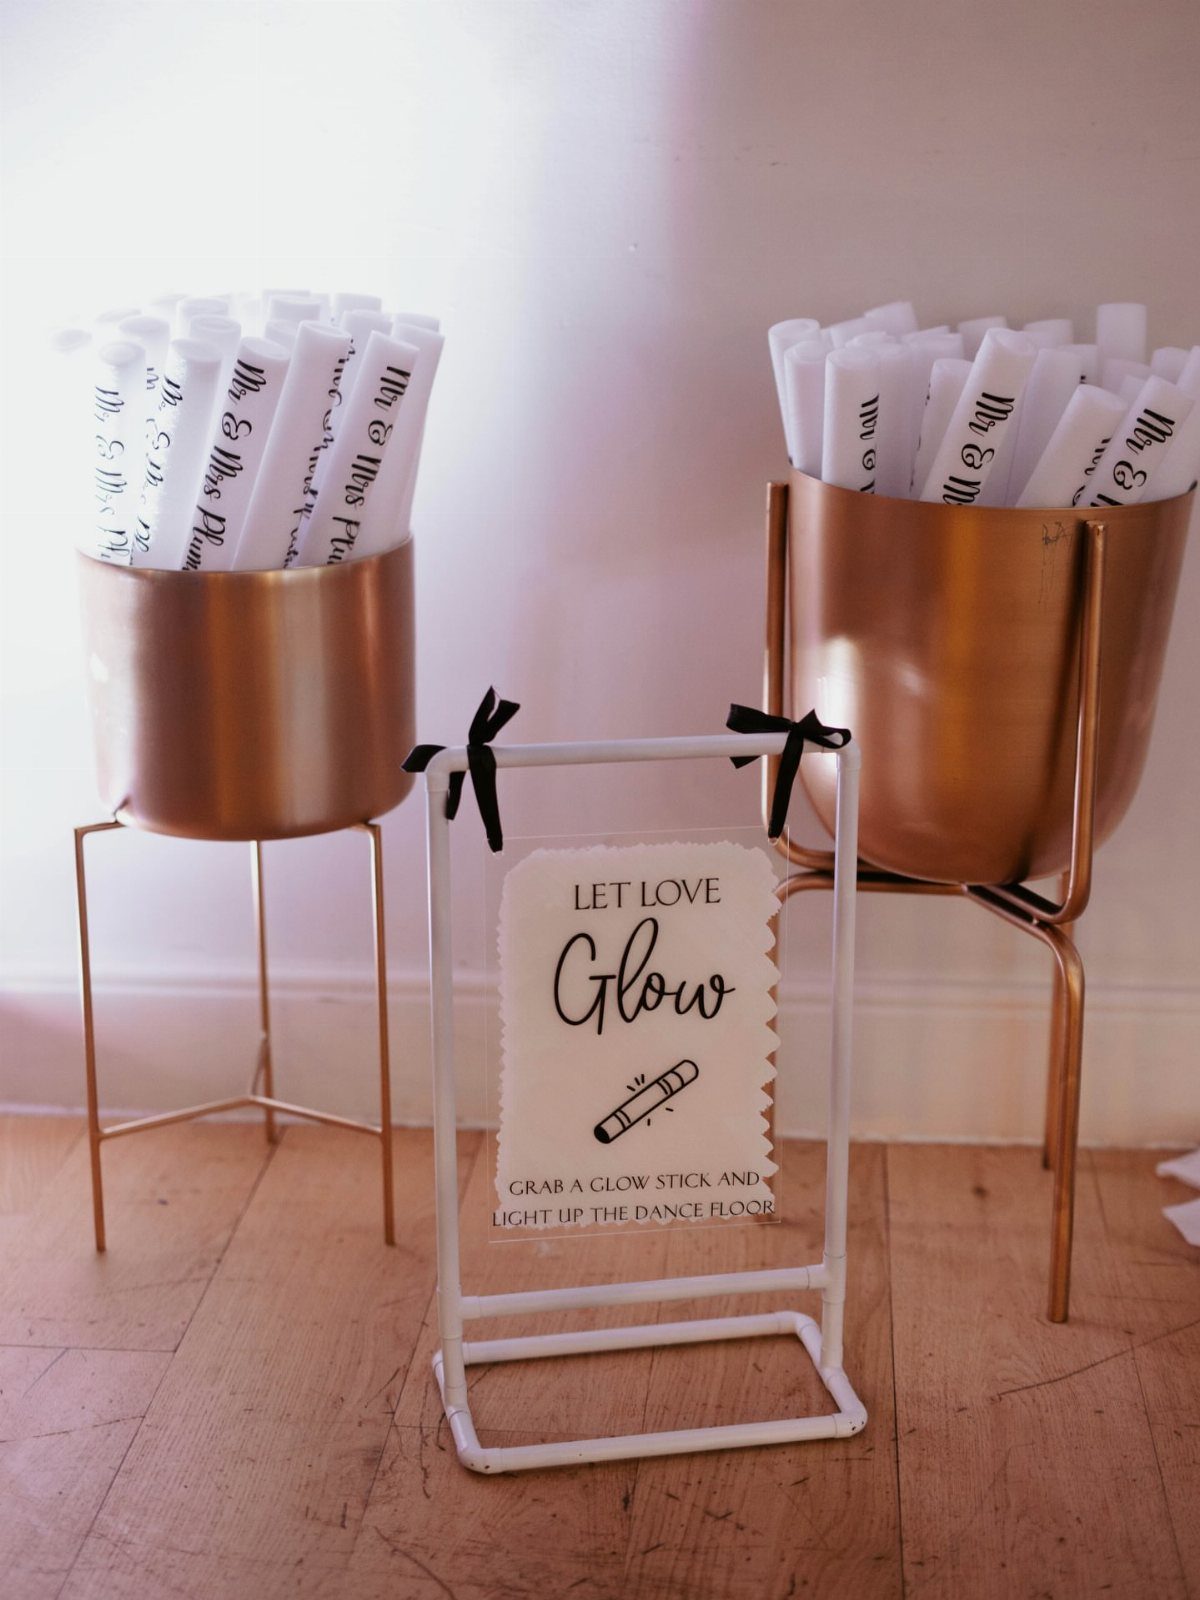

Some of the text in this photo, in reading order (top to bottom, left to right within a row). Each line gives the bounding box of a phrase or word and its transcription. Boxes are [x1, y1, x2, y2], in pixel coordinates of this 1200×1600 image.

[227, 358, 267, 405] Mr
[221, 411, 253, 441] &
[968, 391, 1015, 437] Mr
[327, 365, 411, 565] Mr & Mrs Plu
[961, 443, 995, 470] &
[1112, 408, 1176, 491] Mr &
[203, 445, 244, 501] Mrs
[574, 877, 722, 911] LET LOVE
[553, 917, 737, 1036] Glow
[509, 1171, 760, 1196] GRAB A GLOW STICK AND
[492, 1200, 775, 1227] LIGHT UP THE DANCE FLOOR
